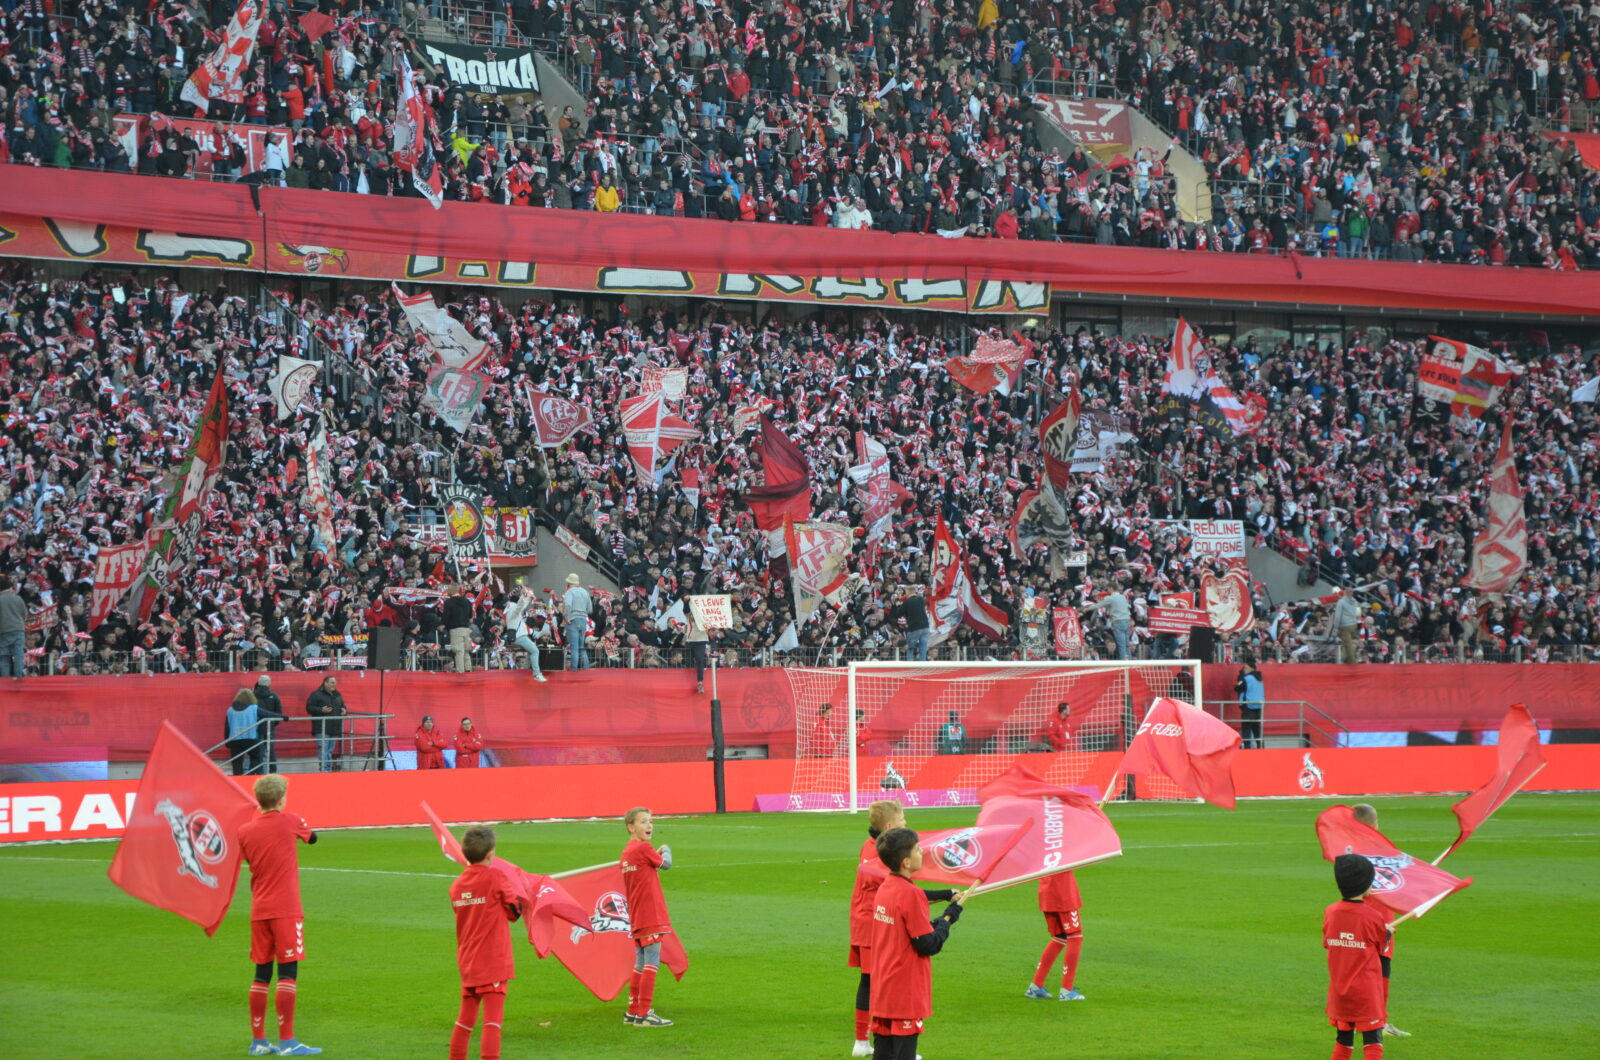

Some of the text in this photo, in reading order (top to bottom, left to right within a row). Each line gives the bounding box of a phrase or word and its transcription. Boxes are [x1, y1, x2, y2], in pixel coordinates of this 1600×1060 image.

[425, 44, 540, 93] TROIKA
[443, 485, 478, 500] JUNGE
[504, 519, 528, 538] 51
[1193, 523, 1241, 535] REDLINE
[1194, 541, 1243, 554] COLOGNE
[1340, 932, 1354, 940] FC
